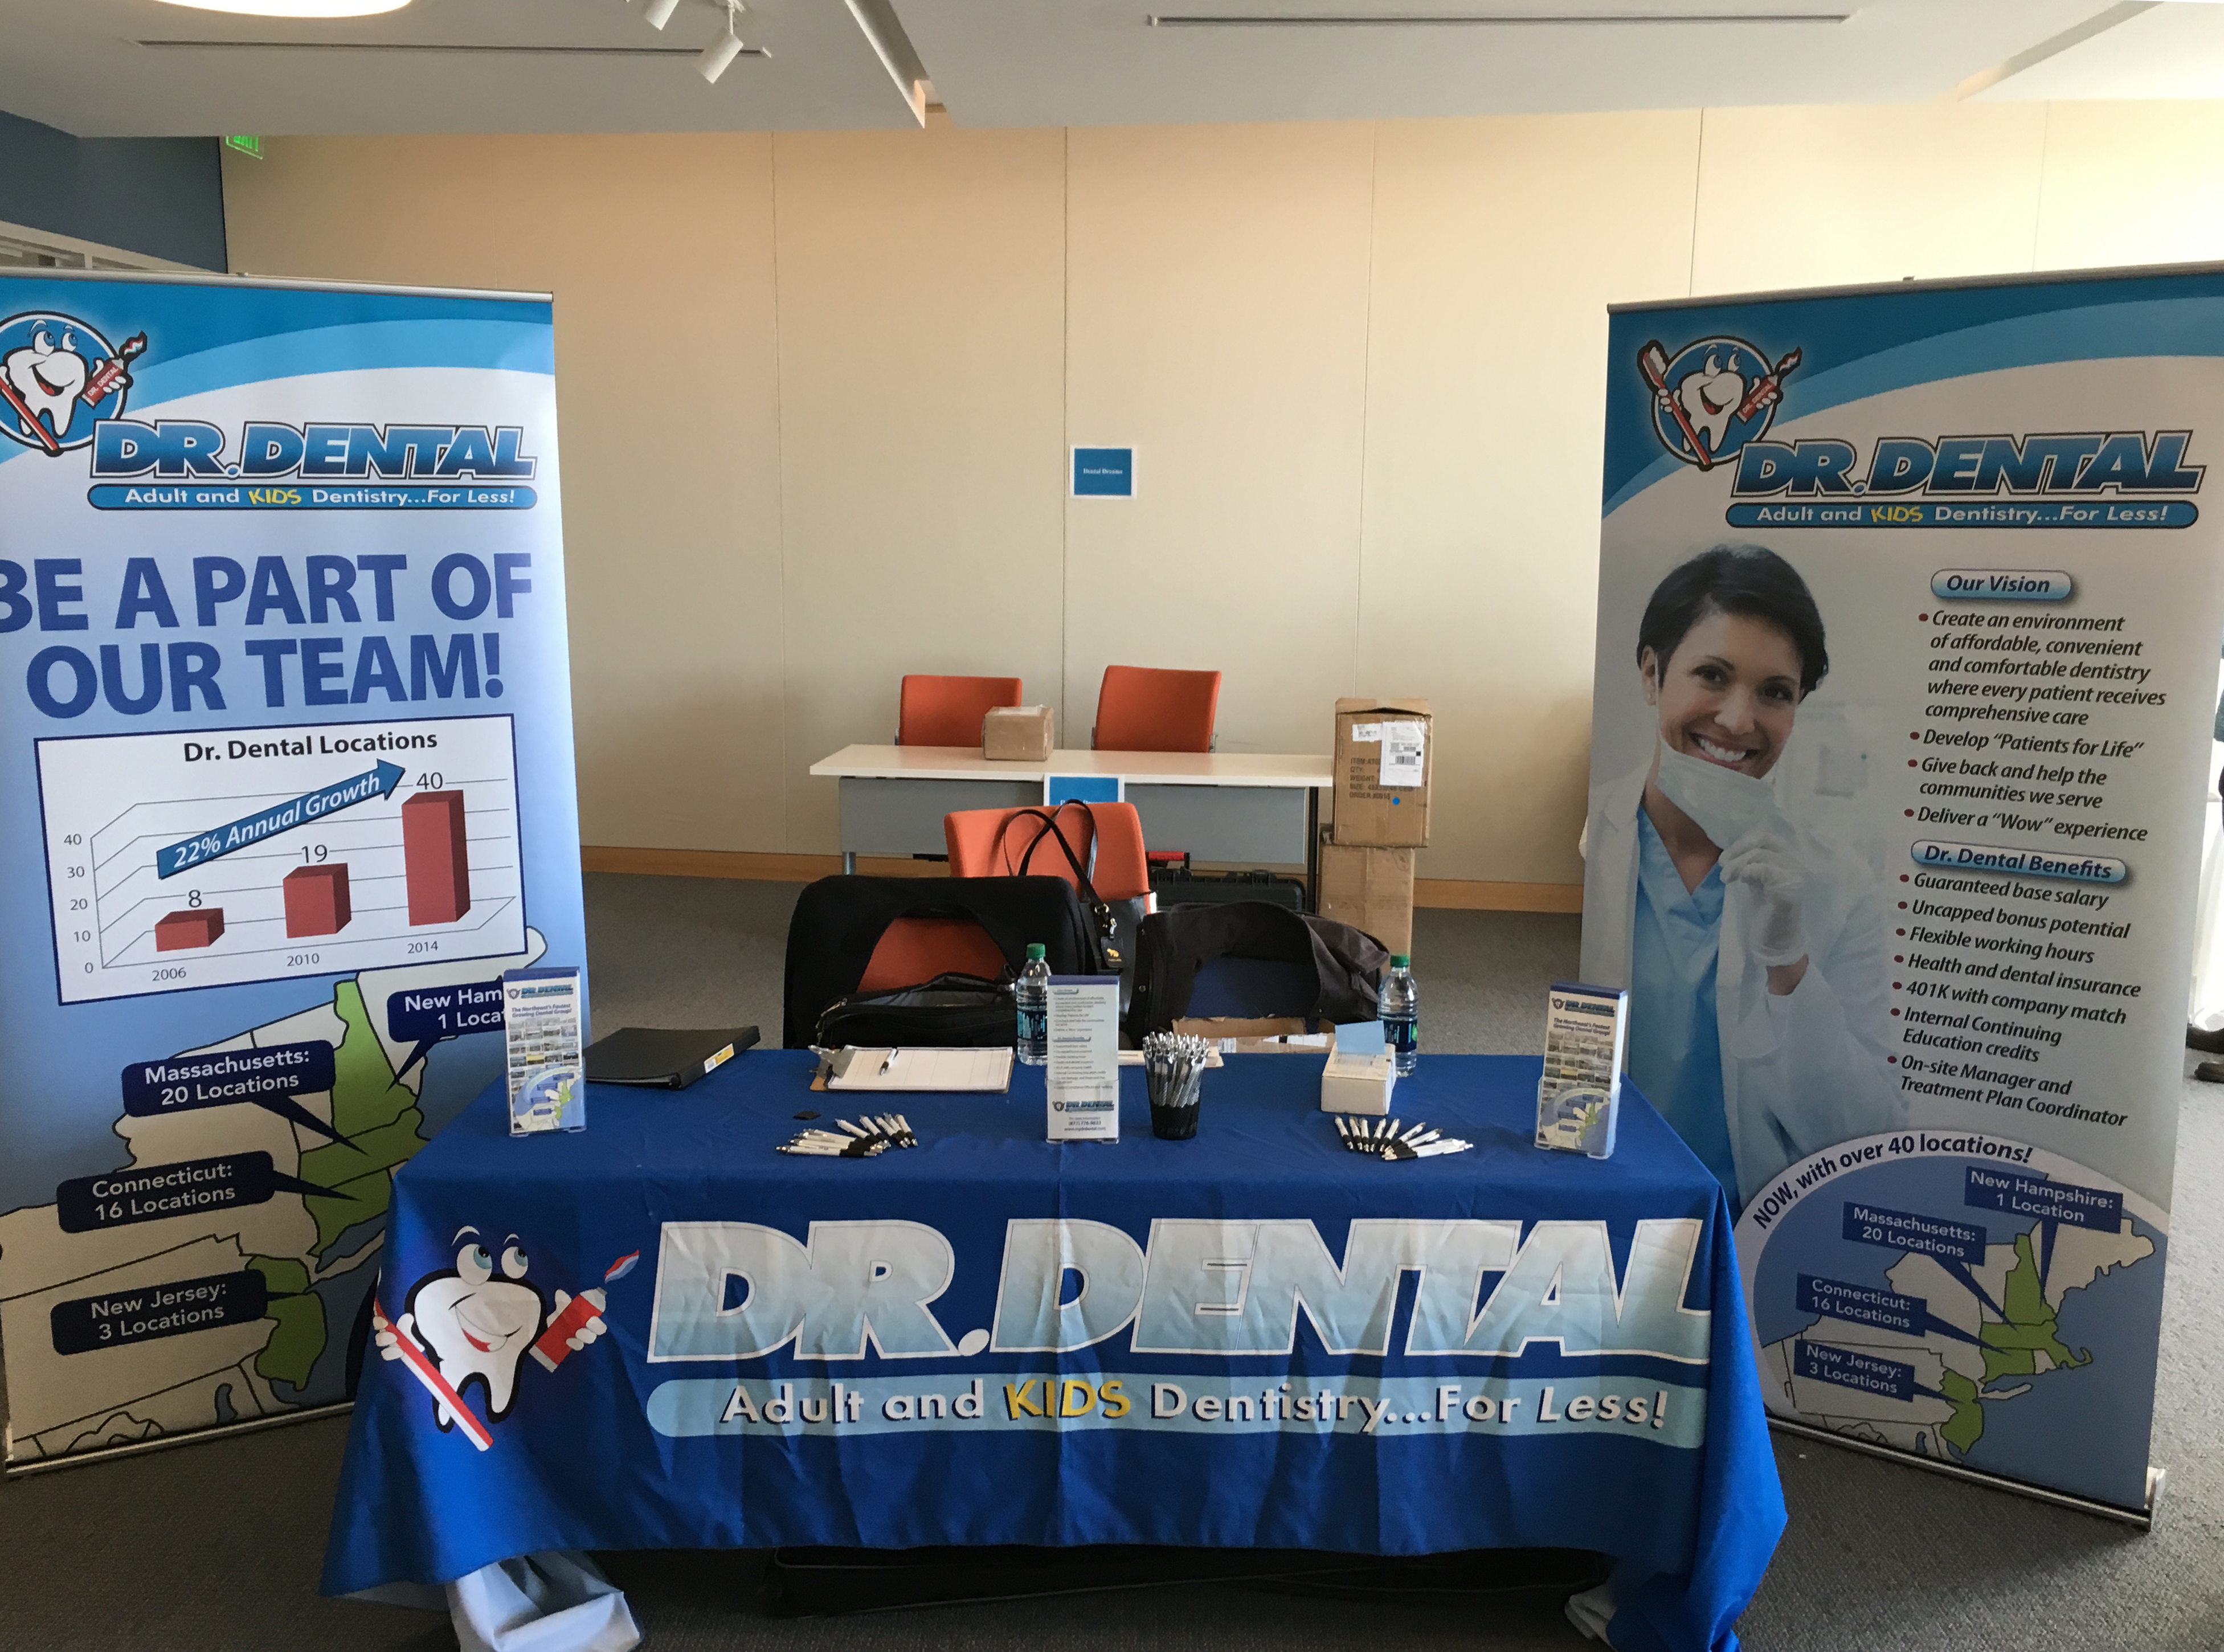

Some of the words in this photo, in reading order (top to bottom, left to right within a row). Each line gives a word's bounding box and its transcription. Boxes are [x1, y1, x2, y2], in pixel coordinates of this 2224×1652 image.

[125, 488, 187, 504] Adult
[197, 488, 239, 503] and
[248, 488, 301, 506] KIDS
[468, 489, 514, 503] Less!
[1757, 505, 1813, 522] Adult
[1821, 505, 1861, 521] and
[1870, 505, 1923, 524] KIDS
[2106, 505, 2168, 521] Less!
[0, 558, 89, 633] BE
[115, 557, 179, 629] A
[194, 554, 406, 627] PART
[431, 553, 532, 621] OF
[1947, 575, 1985, 592] Our
[1990, 576, 2050, 594] Vision
[1932, 611, 1984, 627] Create
[1988, 616, 2009, 628] an
[2013, 614, 2125, 632] environment
[1931, 634, 1948, 648] of
[1950, 635, 2041, 655] affordable,
[2046, 640, 2143, 656] convenient
[26, 641, 227, 719] OUR
[245, 633, 504, 709] TEAM!
[1928, 657, 1962, 672] and
[1964, 657, 2067, 677] comfortable
[2070, 663, 2150, 684] dentistry
[1928, 680, 1979, 696] where
[1981, 685, 2027, 702] every
[2029, 687, 2094, 703] patient
[2096, 690, 2166, 706] receives
[1925, 704, 2050, 725] comprehensive
[2053, 711, 2089, 725] care
[184, 742, 220, 762] Dr.
[228, 736, 312, 758] Dental
[319, 732, 438, 755] Locations
[1923, 730, 1989, 749] Develop
[1994, 734, 2068, 754] “Patients
[2072, 738, 2098, 755] for
[2100, 740, 2144, 758] Life”
[416, 772, 443, 791] 40
[1922, 758, 1956, 775] Give
[1961, 760, 1997, 777] back
[2001, 762, 2033, 780] and
[2037, 765, 2074, 786] help
[2078, 768, 2107, 786] the
[1919, 781, 2025, 803] communities
[2029, 790, 2054, 805] we
[2058, 792, 2103, 808] serve
[173, 836, 220, 869] 22%
[226, 802, 300, 847] Annual
[306, 772, 381, 817] Growth
[1918, 807, 1976, 825] Deliver
[1977, 815, 1988, 827] a
[2054, 822, 2148, 841] experience
[64, 833, 82, 845] 40
[300, 844, 328, 863] 19
[66, 865, 85, 878] 30
[1924, 845, 1952, 861] Dr.
[1957, 848, 2025, 870] Dental
[2029, 856, 2111, 878] Benefits
[69, 898, 88, 910] 20
[188, 890, 202, 908] 8
[1914, 873, 2010, 897] Guaranteed
[2012, 879, 2051, 902] base
[2054, 891, 2109, 910] salary
[1912, 899, 1994, 923] Uncapped
[1996, 909, 2047, 929] bonus
[2049, 918, 2131, 939] potential
[73, 930, 91, 942] 10
[407, 940, 439, 954] 2014
[1910, 926, 1972, 948] Flexible
[1975, 939, 2042, 960] working
[2045, 943, 2095, 964] hours
[84, 962, 93, 974] 0
[152, 967, 186, 982] 2006
[287, 952, 320, 967] 2010
[1908, 954, 1961, 974] Health
[1965, 962, 1998, 978] and
[2000, 964, 2055, 986] dental
[2057, 972, 2141, 997] insurance
[404, 992, 451, 1013] New
[458, 986, 502, 1007] Ham
[1906, 982, 1950, 999] 401K
[1951, 987, 1988, 1004] with
[1991, 993, 2068, 1019] company
[2071, 1004, 2126, 1025] match
[438, 1013, 447, 1029] 1
[1904, 1007, 1969, 1029] Internal
[1972, 1017, 2062, 1046] Continuing
[1903, 1029, 1982, 1053] Education
[1985, 1043, 2041, 1063] credits
[145, 1048, 310, 1085] Massachusetts:
[1901, 1055, 1958, 1077] On-site
[1960, 1064, 2036, 1090] Manager
[2038, 1079, 2072, 1095] and
[161, 1087, 189, 1106] 20
[197, 1073, 299, 1102] Locations
[1900, 1076, 1984, 1103] Treatment
[1986, 1089, 2022, 1109] Plan
[2026, 1097, 2128, 1127] Coordinator
[92, 1162, 232, 1199] Connecticut:
[1752, 1180, 1800, 1230] NOW,
[1796, 1157, 1838, 1190] with
[1839, 1143, 1884, 1170] over
[1888, 1136, 1915, 1154] 40
[1920, 1134, 2034, 1164] locations!
[1970, 1171, 2010, 1190] New
[2015, 1178, 2114, 1210] Hampshire:
[95, 1201, 122, 1221] 16
[130, 1184, 235, 1216] Locations
[1996, 1193, 2004, 1207] 1
[2012, 1196, 2084, 1222] Location
[1853, 1208, 1976, 1242] Massachusetts:
[1862, 1226, 1882, 1240] 20
[1887, 1229, 1965, 1258] Locations
[90, 1297, 142, 1320] New
[150, 1283, 227, 1310] Jersey:
[1812, 1279, 1911, 1311] Connecticut:
[99, 1323, 112, 1341] 3
[120, 1303, 224, 1336] Locations
[1812, 1296, 1830, 1310] 16
[1834, 1299, 1911, 1328] Locations
[1806, 1345, 1843, 1364] New
[1846, 1355, 1902, 1379] Jersey:
[1809, 1362, 1818, 1375] 3
[1823, 1366, 1898, 1395] Locations
[719, 1381, 864, 1425] Adult
[881, 1377, 985, 1418] and
[1001, 1377, 1131, 1421] KIDS
[1536, 1387, 1669, 1429] Less!
